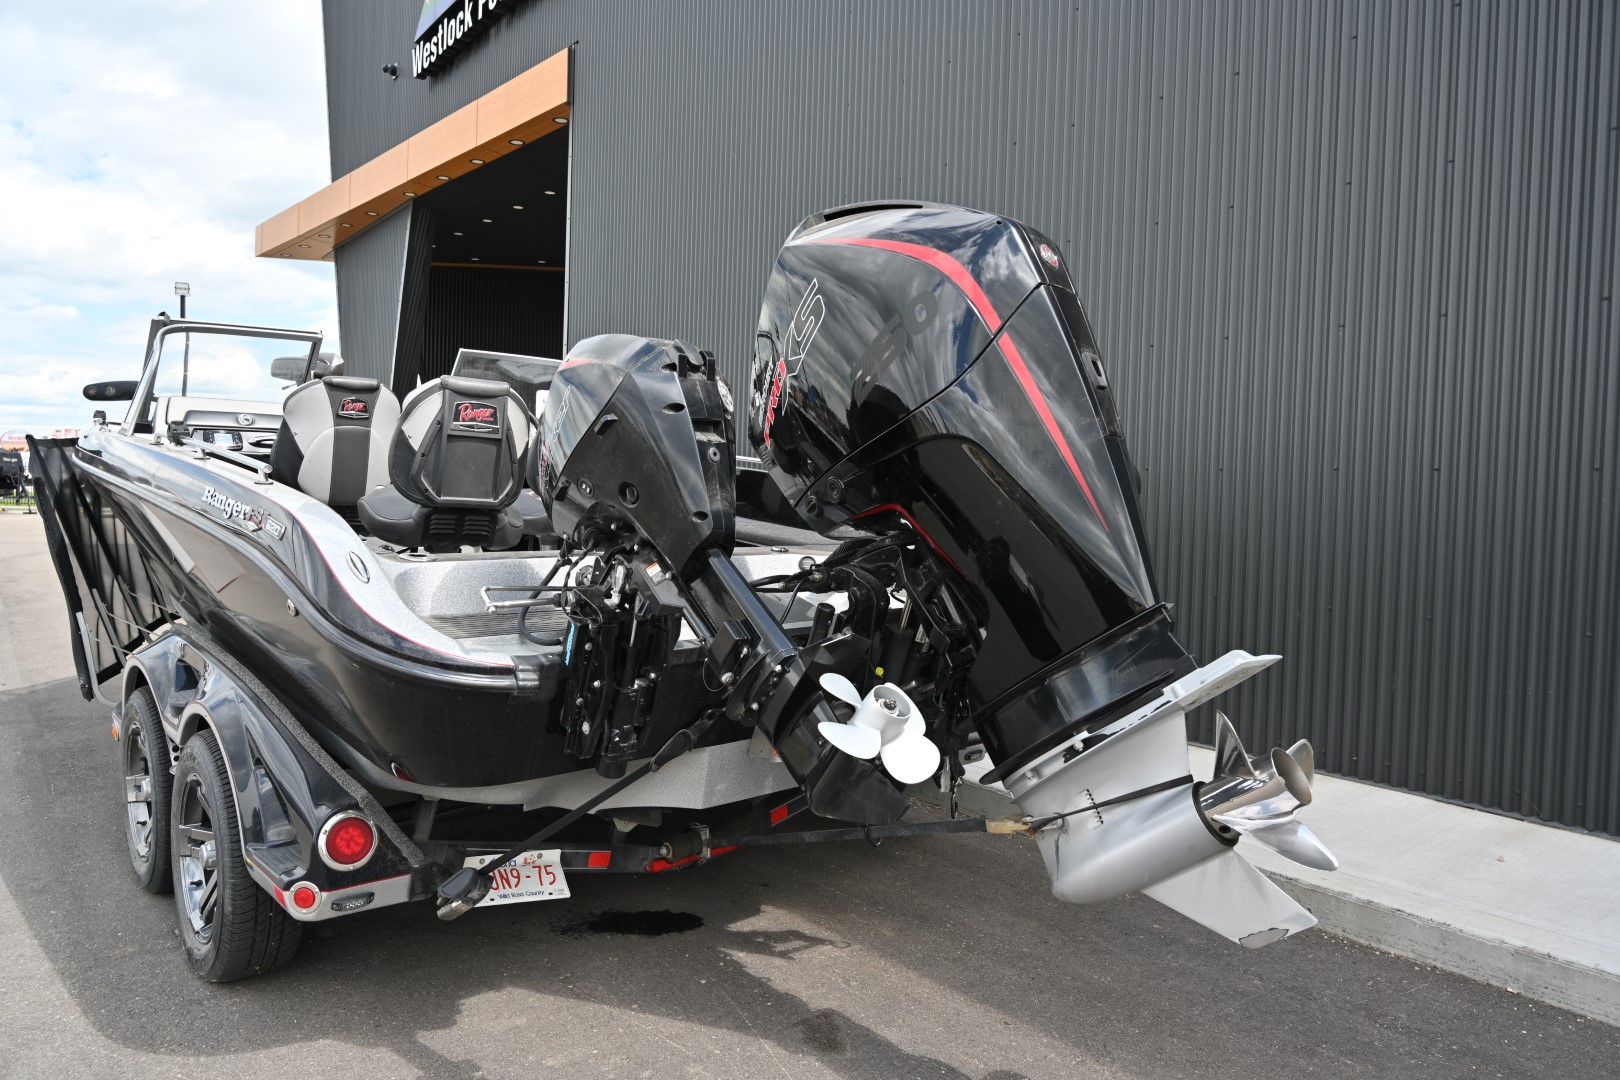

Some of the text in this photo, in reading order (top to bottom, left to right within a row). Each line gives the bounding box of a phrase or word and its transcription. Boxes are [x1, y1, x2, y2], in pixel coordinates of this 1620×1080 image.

[411, 0, 474, 78] Westlock
[343, 399, 367, 412] Ranger
[458, 402, 495, 422] Ranger
[201, 485, 250, 520] Ranger
[265, 519, 281, 536] 620
